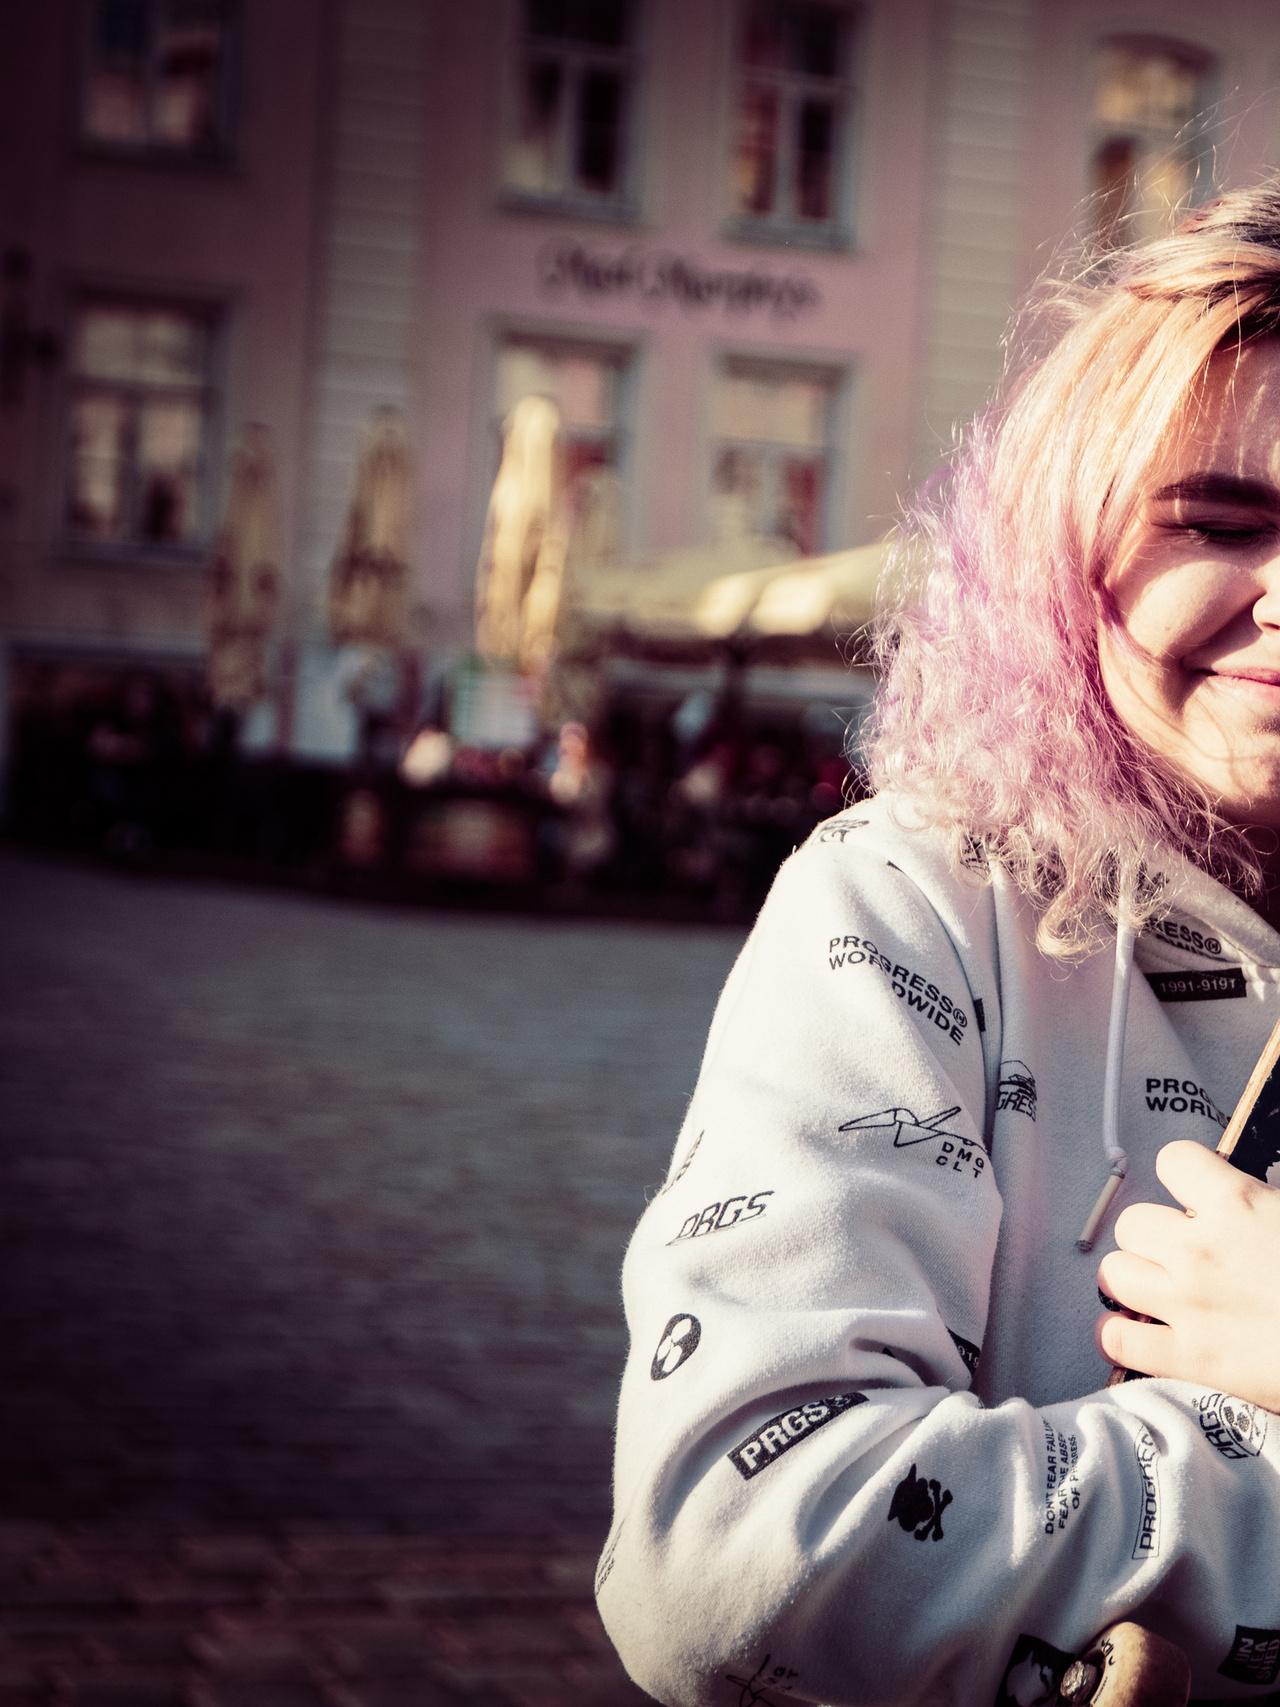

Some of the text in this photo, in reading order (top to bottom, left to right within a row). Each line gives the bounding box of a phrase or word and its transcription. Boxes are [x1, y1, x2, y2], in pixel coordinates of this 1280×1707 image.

[936, 1155, 981, 1178] CLT
[1047, 1455, 1057, 1489] FEAR
[1058, 1489, 1069, 1529] FEAR
[1071, 1487, 1081, 1509] OF
